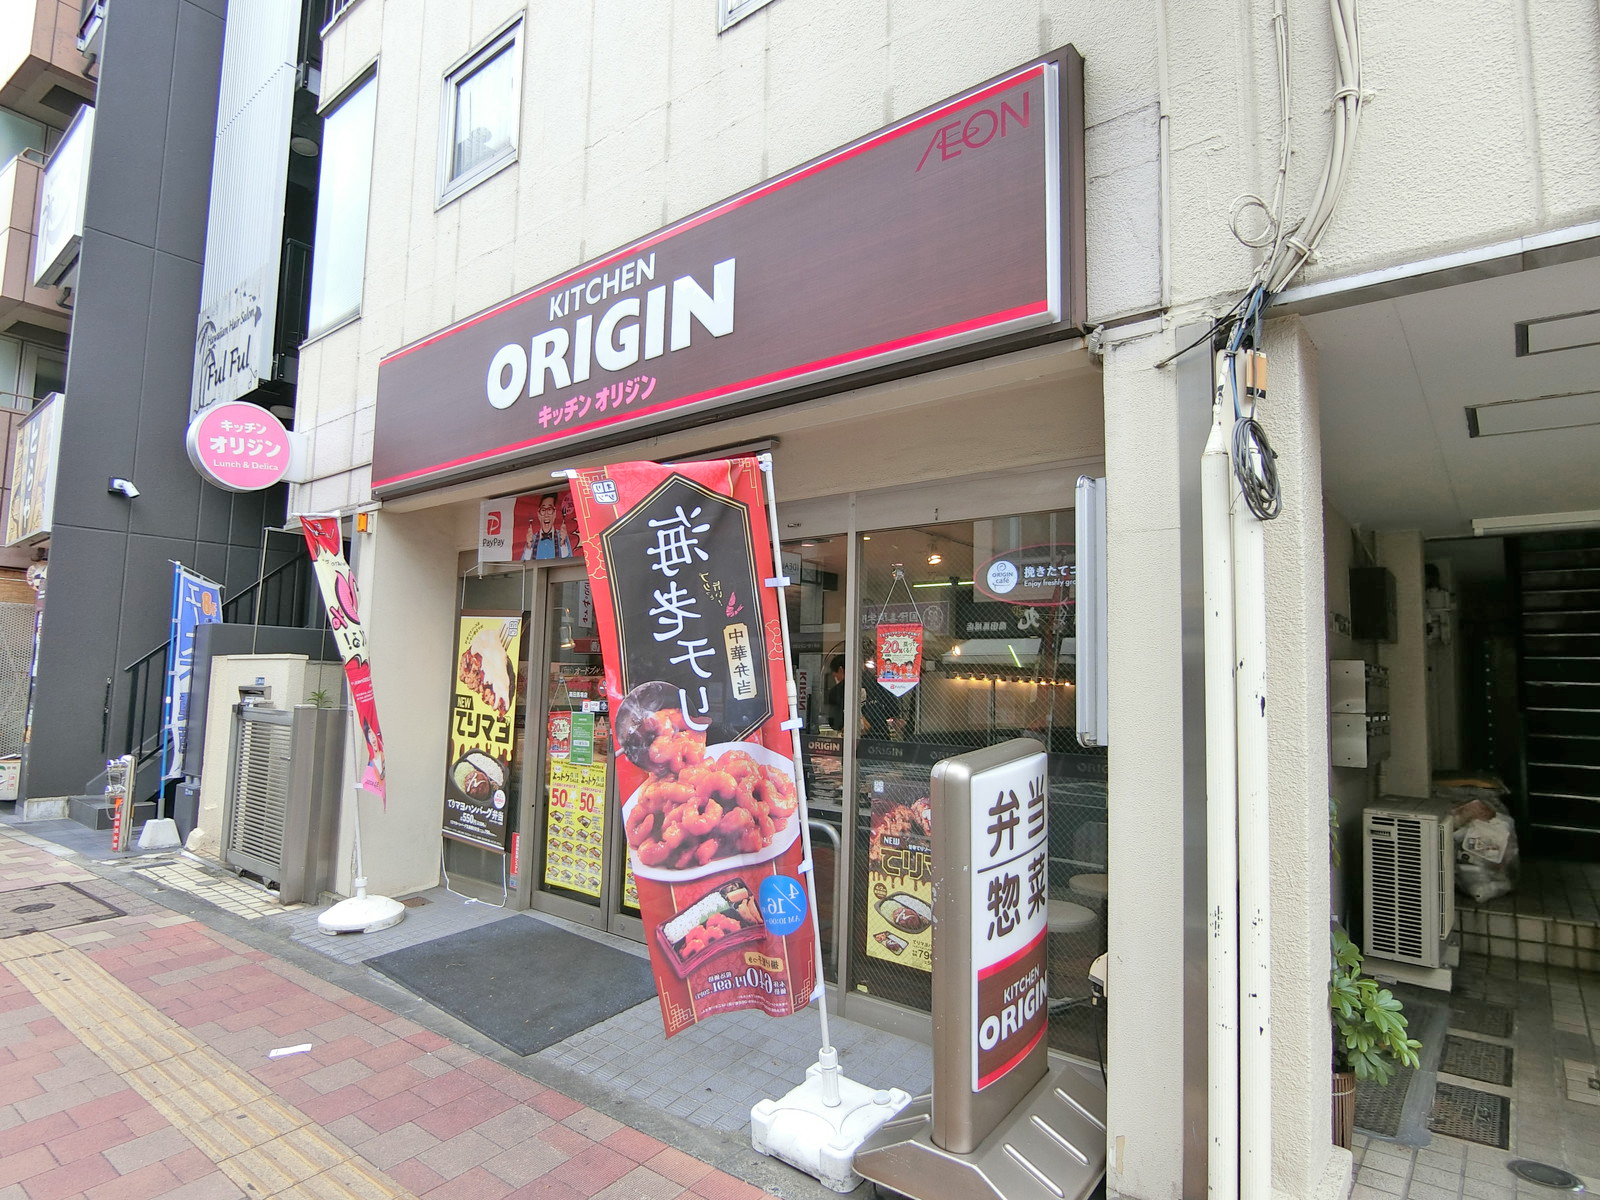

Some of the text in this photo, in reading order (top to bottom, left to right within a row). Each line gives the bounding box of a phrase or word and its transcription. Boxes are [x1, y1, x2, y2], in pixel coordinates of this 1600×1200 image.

[549, 252, 656, 322] KITCHEN
[229, 318, 240, 335] Hair
[240, 308, 255, 326] Salon
[485, 258, 736, 410] ORIGIN
[207, 334, 252, 391] Ful Ful
[538, 374, 658, 429] キッチン オリジン
[221, 420, 267, 435] キッチン
[209, 435, 281, 458] オリジン
[213, 459, 279, 471] Lunch & Delica
[482, 537, 505, 548] PayPay
[1024, 580, 1042, 588] Enjoy
[1043, 579, 1064, 587] freshly
[457, 697, 472, 708] NEW
[455, 710, 511, 744] てりマヨ
[808, 741, 841, 752] ORIGIN
[551, 788, 568, 807] 50
[579, 792, 595, 812] 50
[987, 774, 1045, 858] 弁当
[883, 837, 900, 845] NEW
[987, 852, 1045, 941] 惣菜
[1003, 963, 1040, 1004] KITCHEN
[979, 968, 1048, 1051] ORIGIN
